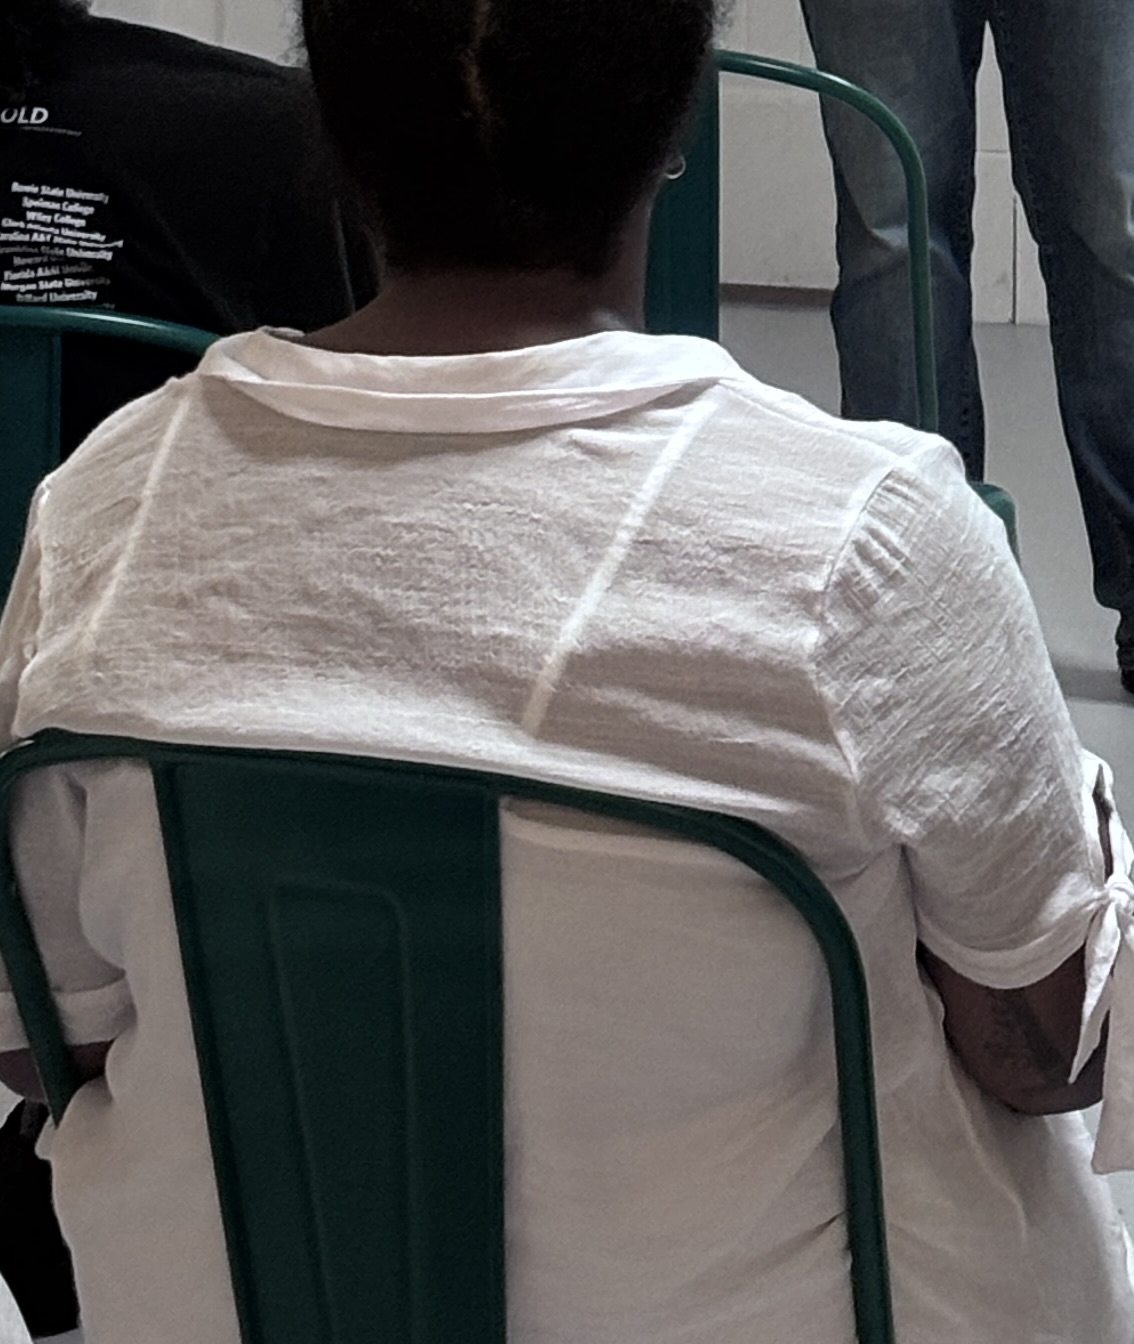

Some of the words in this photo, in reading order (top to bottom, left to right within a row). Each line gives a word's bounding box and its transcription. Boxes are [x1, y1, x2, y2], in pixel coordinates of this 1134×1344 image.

[40, 185, 64, 196] State
[65, 188, 109, 204] University
[22, 196, 60, 210] Spelman
[62, 201, 95, 216] College
[54, 213, 86, 228] College
[61, 227, 106, 242] University
[66, 247, 113, 261] University
[39, 279, 63, 290] State
[49, 289, 98, 303] University
